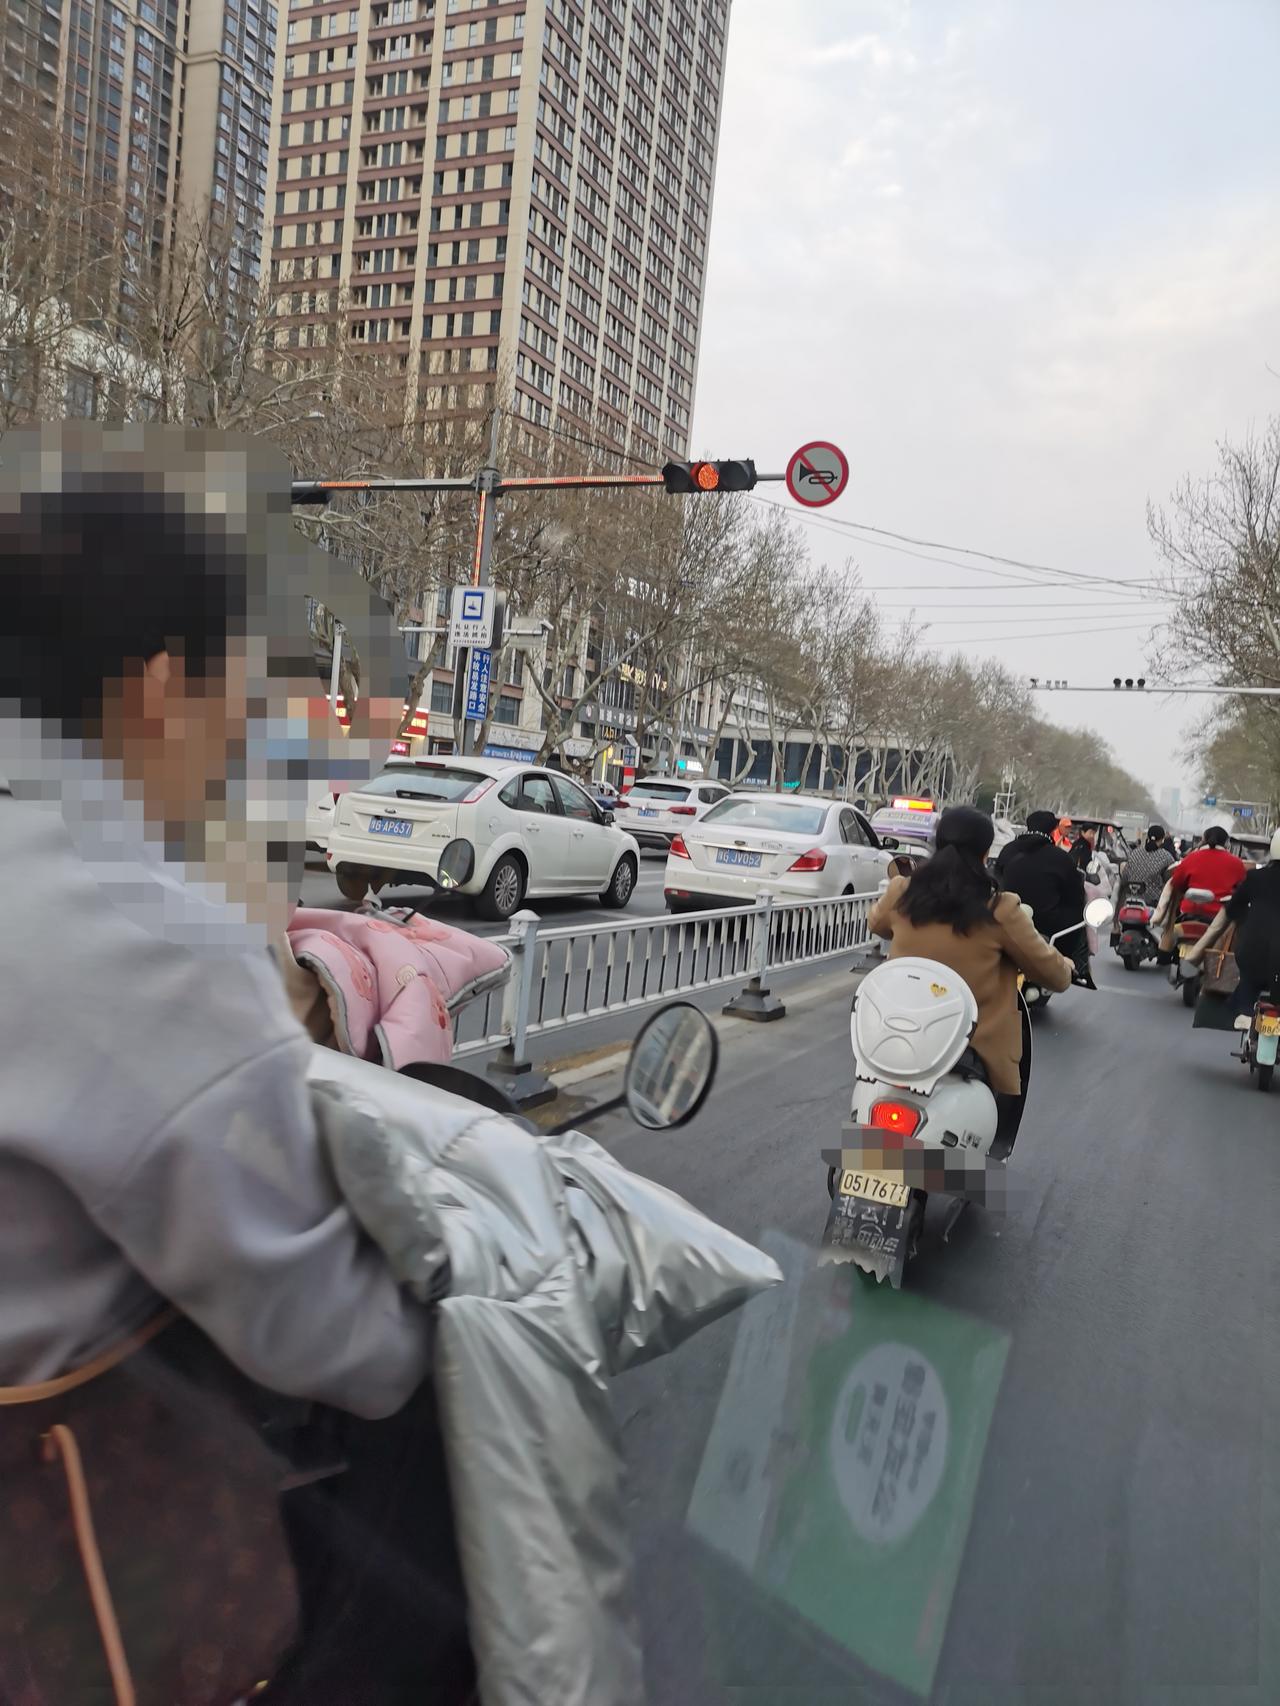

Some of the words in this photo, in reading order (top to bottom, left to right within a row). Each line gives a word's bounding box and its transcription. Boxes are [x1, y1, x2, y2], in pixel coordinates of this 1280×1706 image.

[468, 651, 481, 710] 事故易发路口
[478, 653, 490, 713] 行人注意安全
